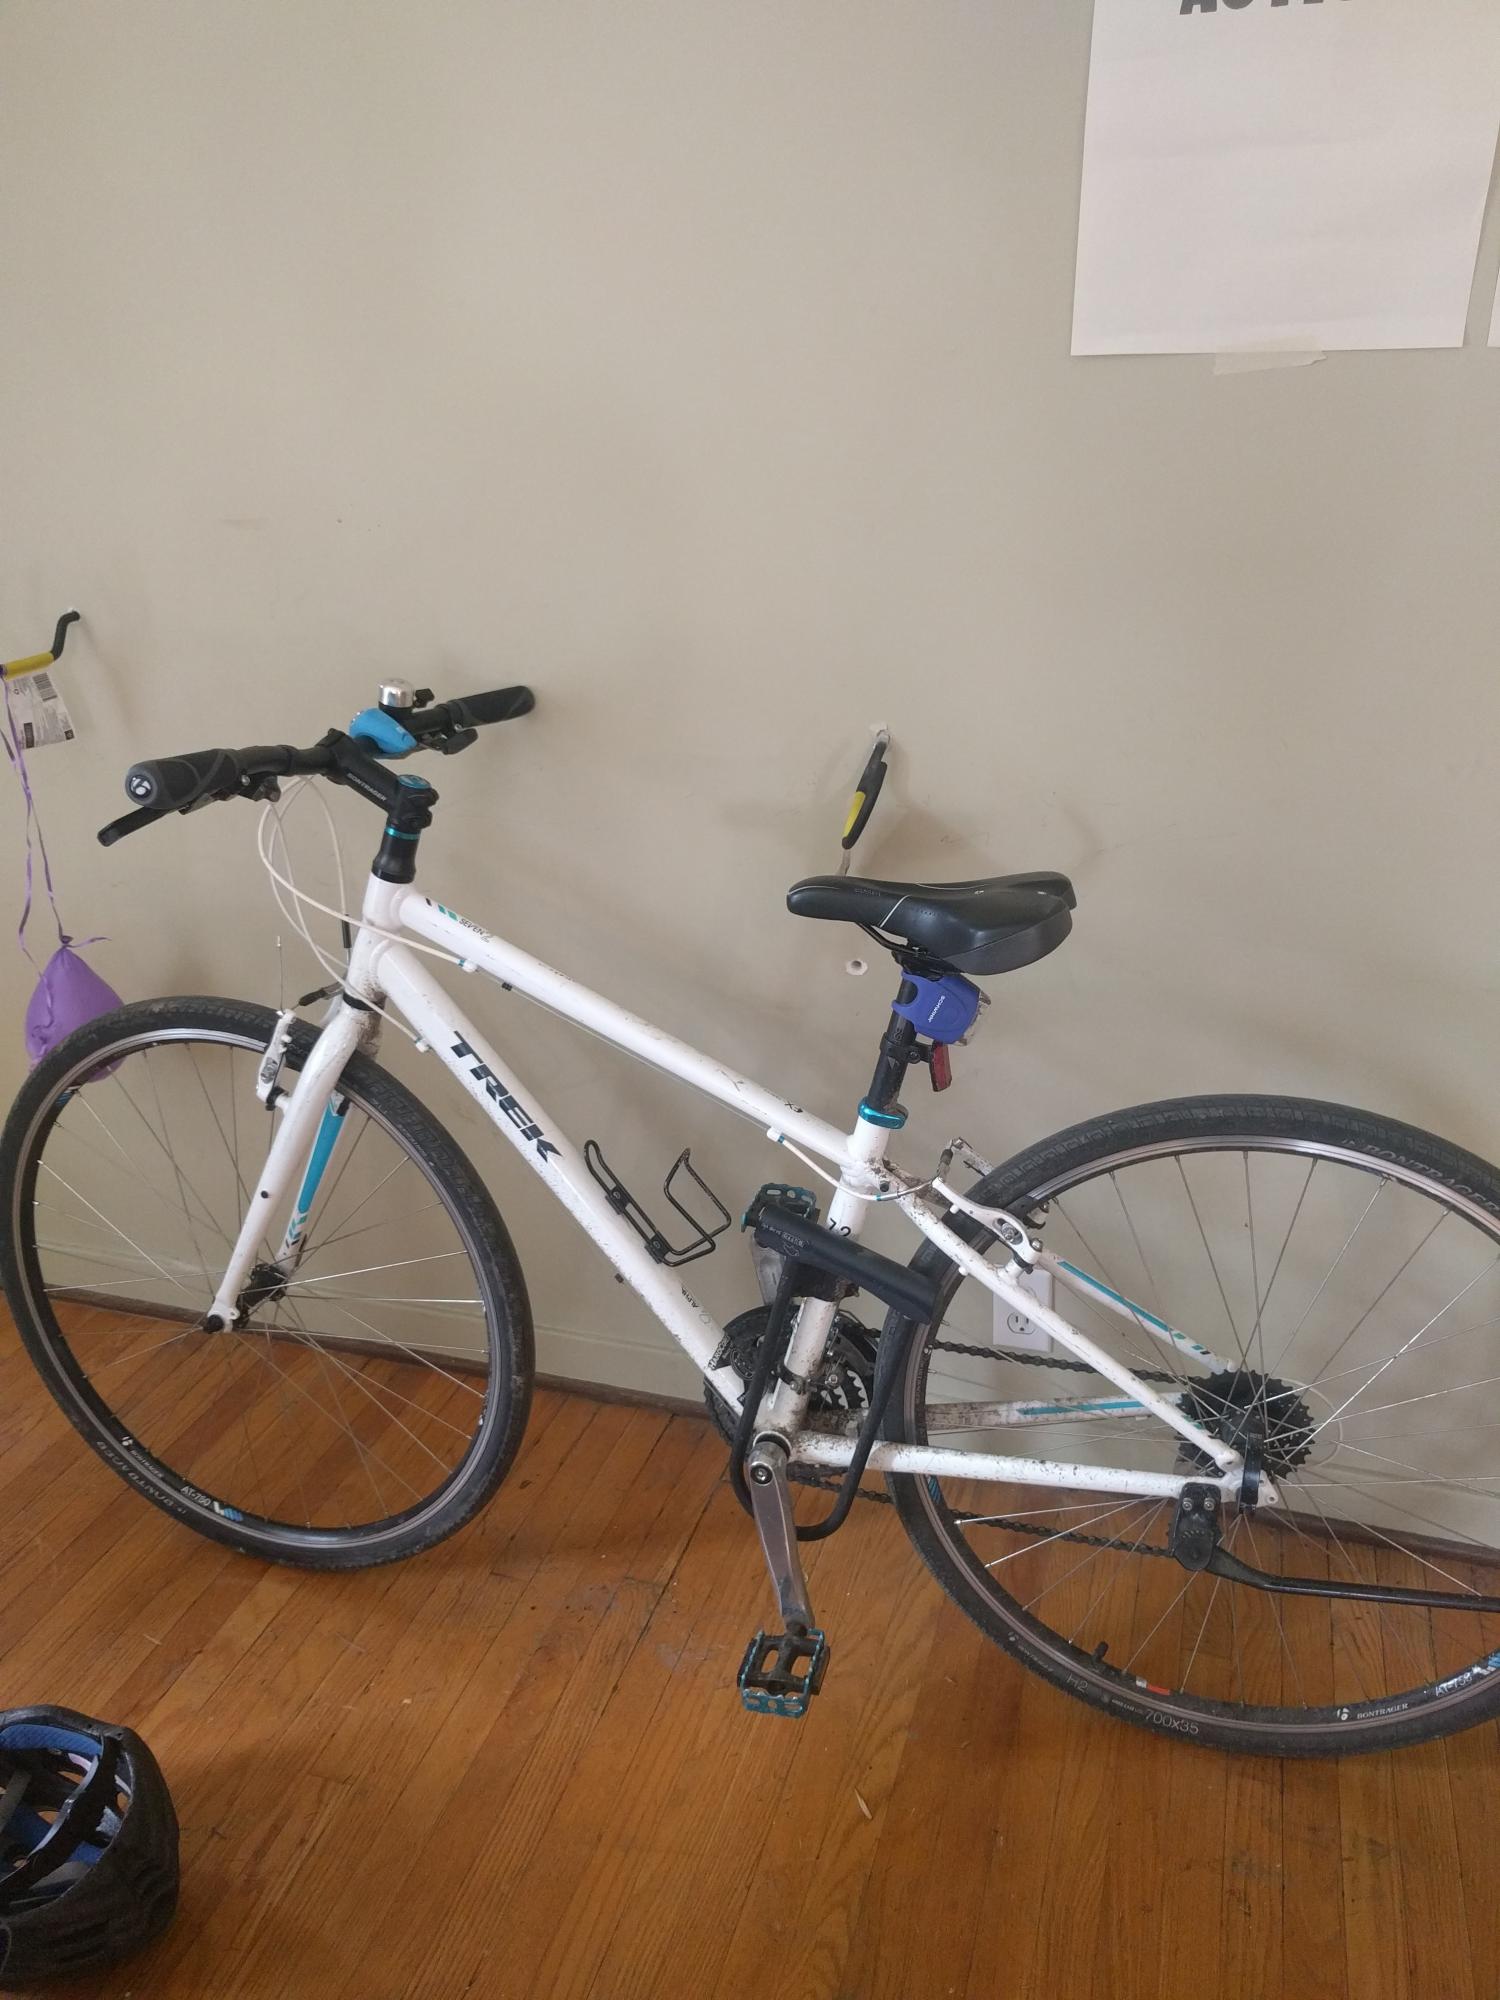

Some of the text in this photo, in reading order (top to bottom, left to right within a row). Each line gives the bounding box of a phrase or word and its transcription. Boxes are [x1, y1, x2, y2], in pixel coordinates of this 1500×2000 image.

[346, 772, 387, 801] BONTRAGER
[928, 995, 946, 1023] SCHWINN
[450, 1030, 563, 1163] TREK
[1145, 1709, 1199, 1735] 700x35
[1357, 1703, 1409, 1719] BONTRAGER
